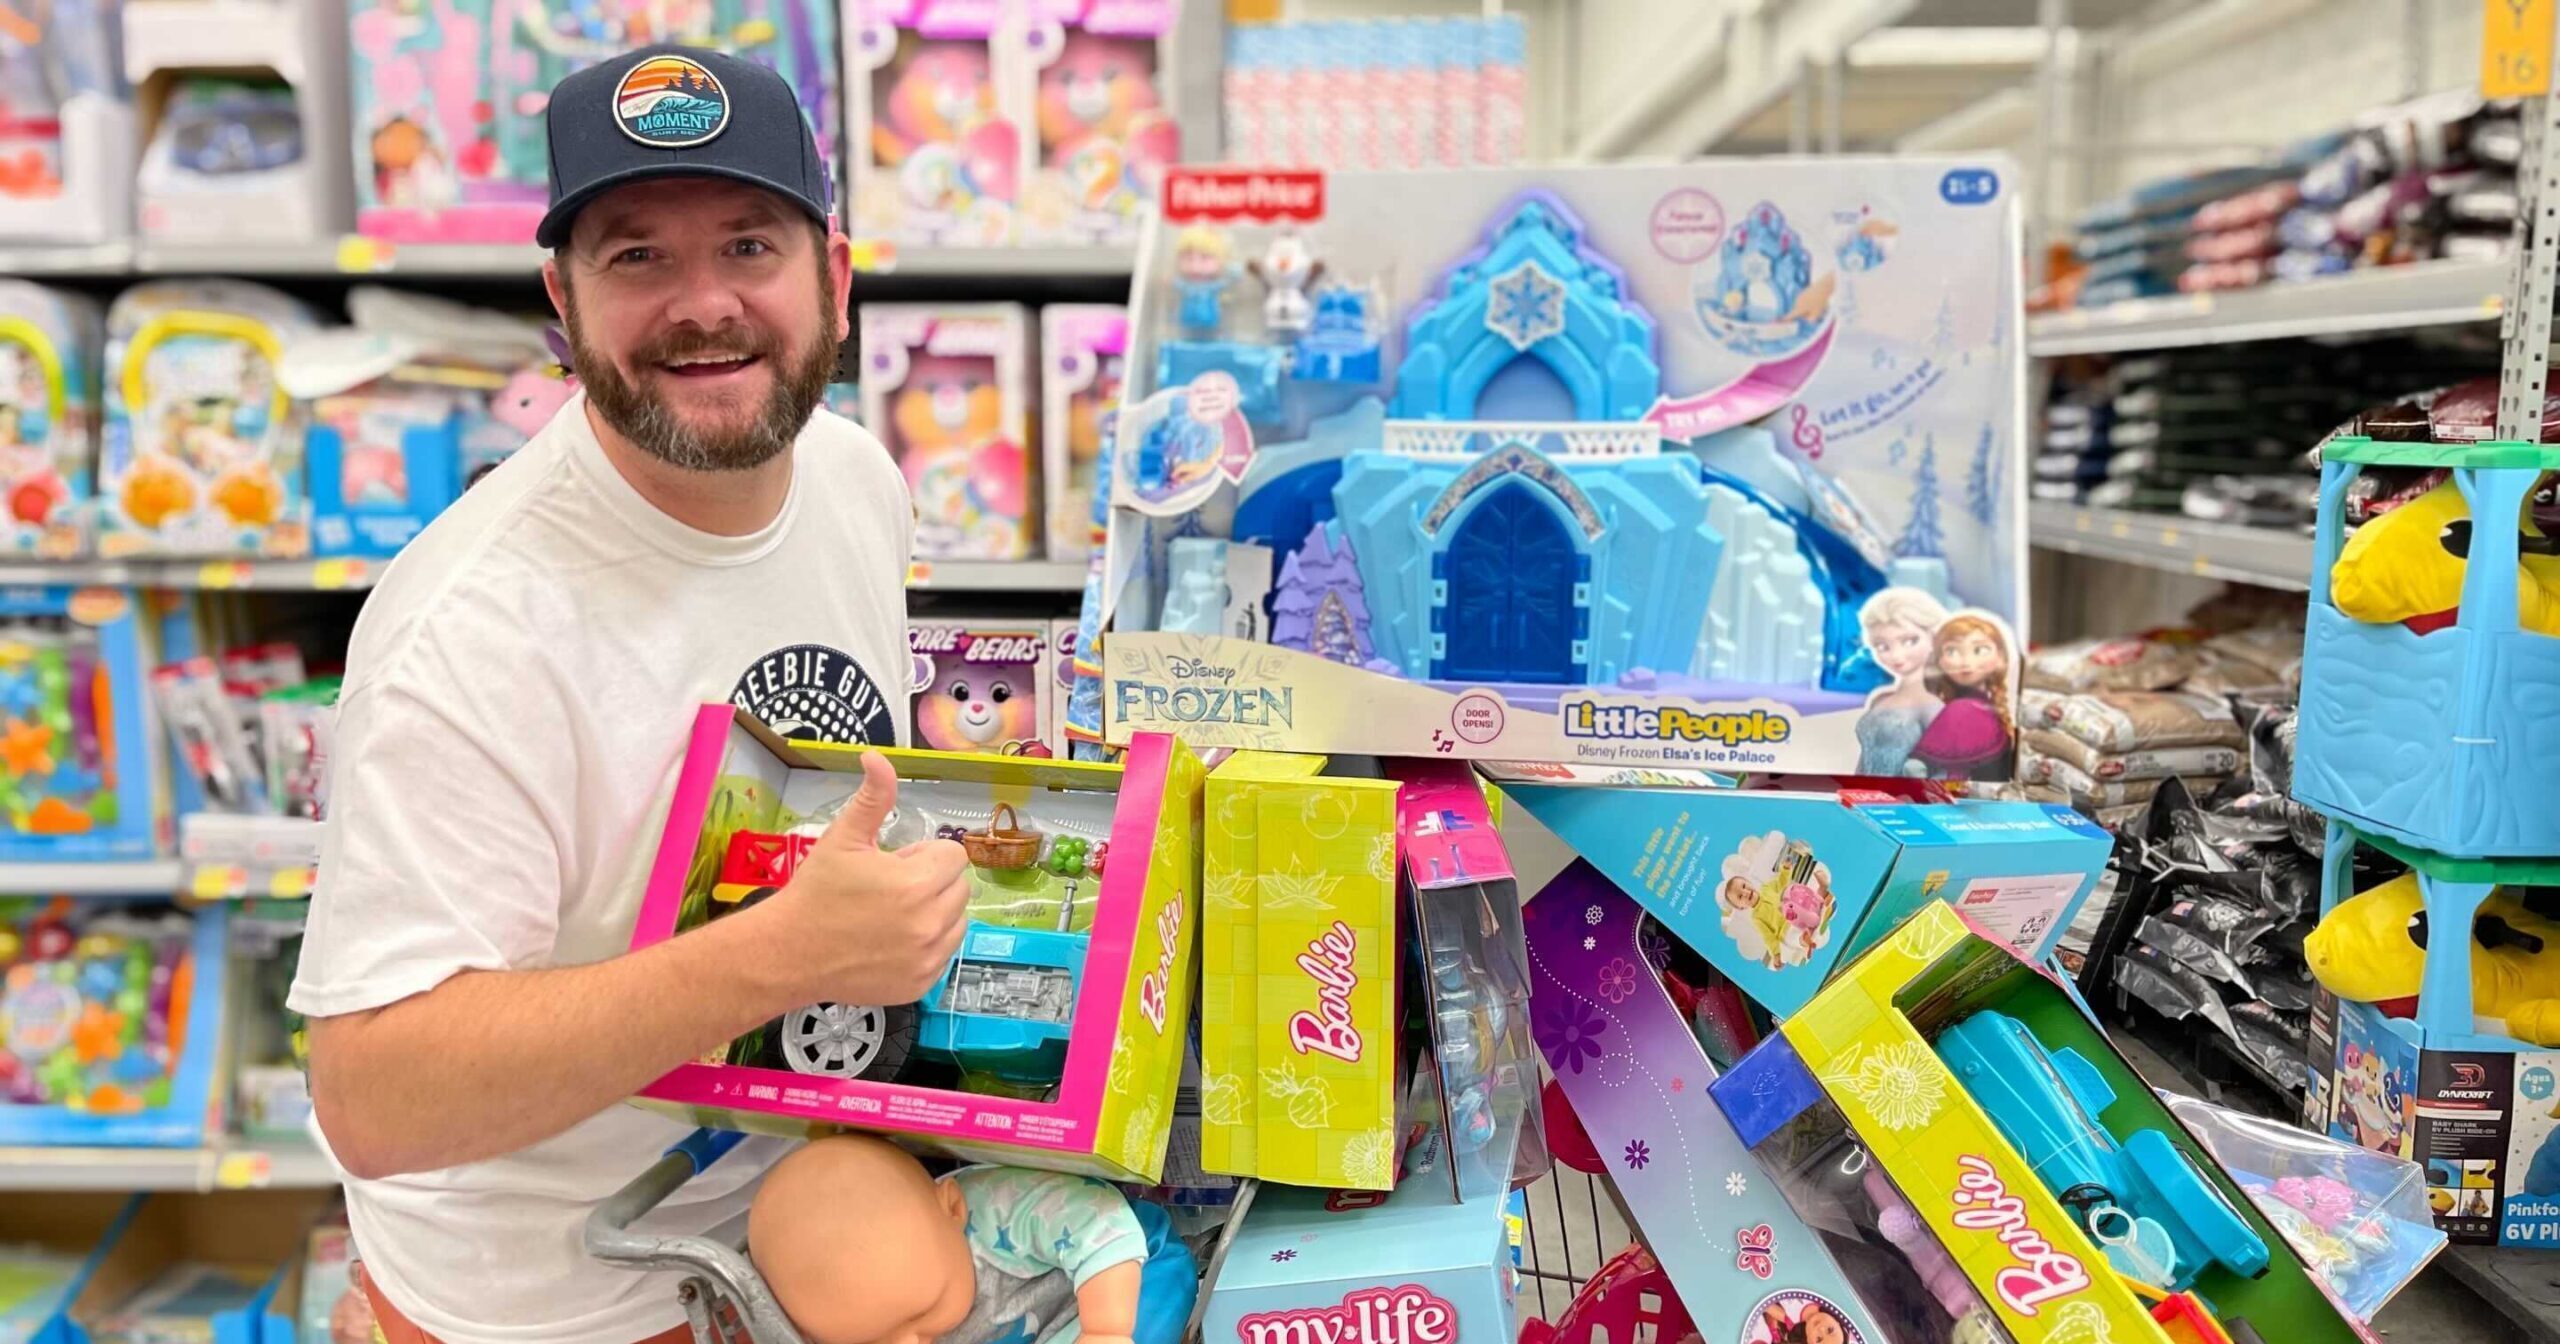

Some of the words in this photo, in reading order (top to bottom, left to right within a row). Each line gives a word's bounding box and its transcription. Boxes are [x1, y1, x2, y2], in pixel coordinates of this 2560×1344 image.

[2497, 49, 2537, 83] 16
[638, 113, 712, 131] MOMENT
[964, 636, 1042, 661] BEARS
[838, 664, 883, 724] GUY
[1114, 679, 1293, 730] FROZEN
[1465, 709, 1491, 718] DOOR
[1462, 719, 1494, 729] OPENS!
[1577, 743, 1616, 760] Disney
[1619, 745, 1660, 759] Frozen
[1663, 747, 1701, 761] Elsa's
[1704, 749, 1726, 761] Ice
[1729, 750, 1775, 764] Palace
[2219, 753, 2235, 768] 20
[1140, 889, 1184, 1036] Barbie
[1289, 920, 1362, 1063] Barbie
[713, 1082, 724, 1094] 3+
[2525, 1073, 2551, 1084] Ages
[2530, 1085, 2544, 1094] 3+
[2507, 1202, 2560, 1217] Pinkfo
[1952, 1154, 2092, 1317] Barbie
[2505, 1223, 2536, 1240] 6V
[2540, 1222, 2560, 1240] Pl
[1354, 1294, 1447, 1342] life
